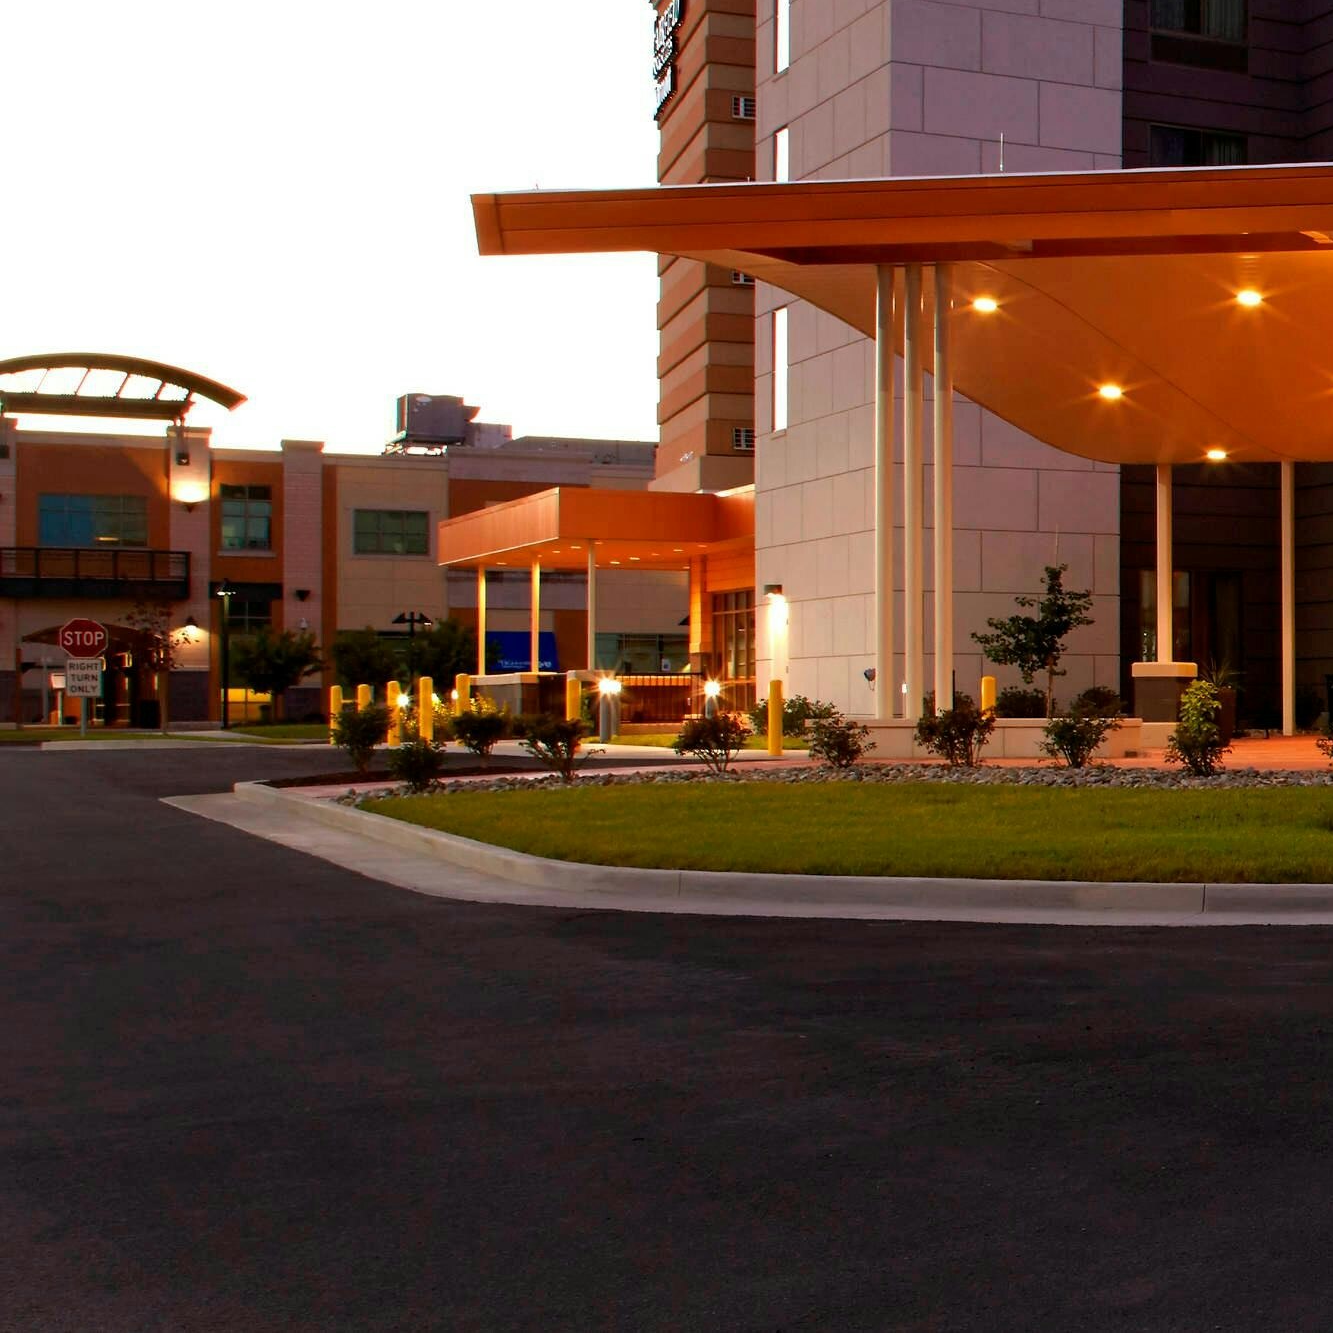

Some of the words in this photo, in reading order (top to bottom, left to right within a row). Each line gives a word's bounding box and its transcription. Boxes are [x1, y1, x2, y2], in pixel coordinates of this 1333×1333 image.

[63, 631, 104, 646] STOP
[68, 662, 99, 671] RIGHT
[70, 674, 98, 682] TURN
[70, 685, 98, 693] ONLY
